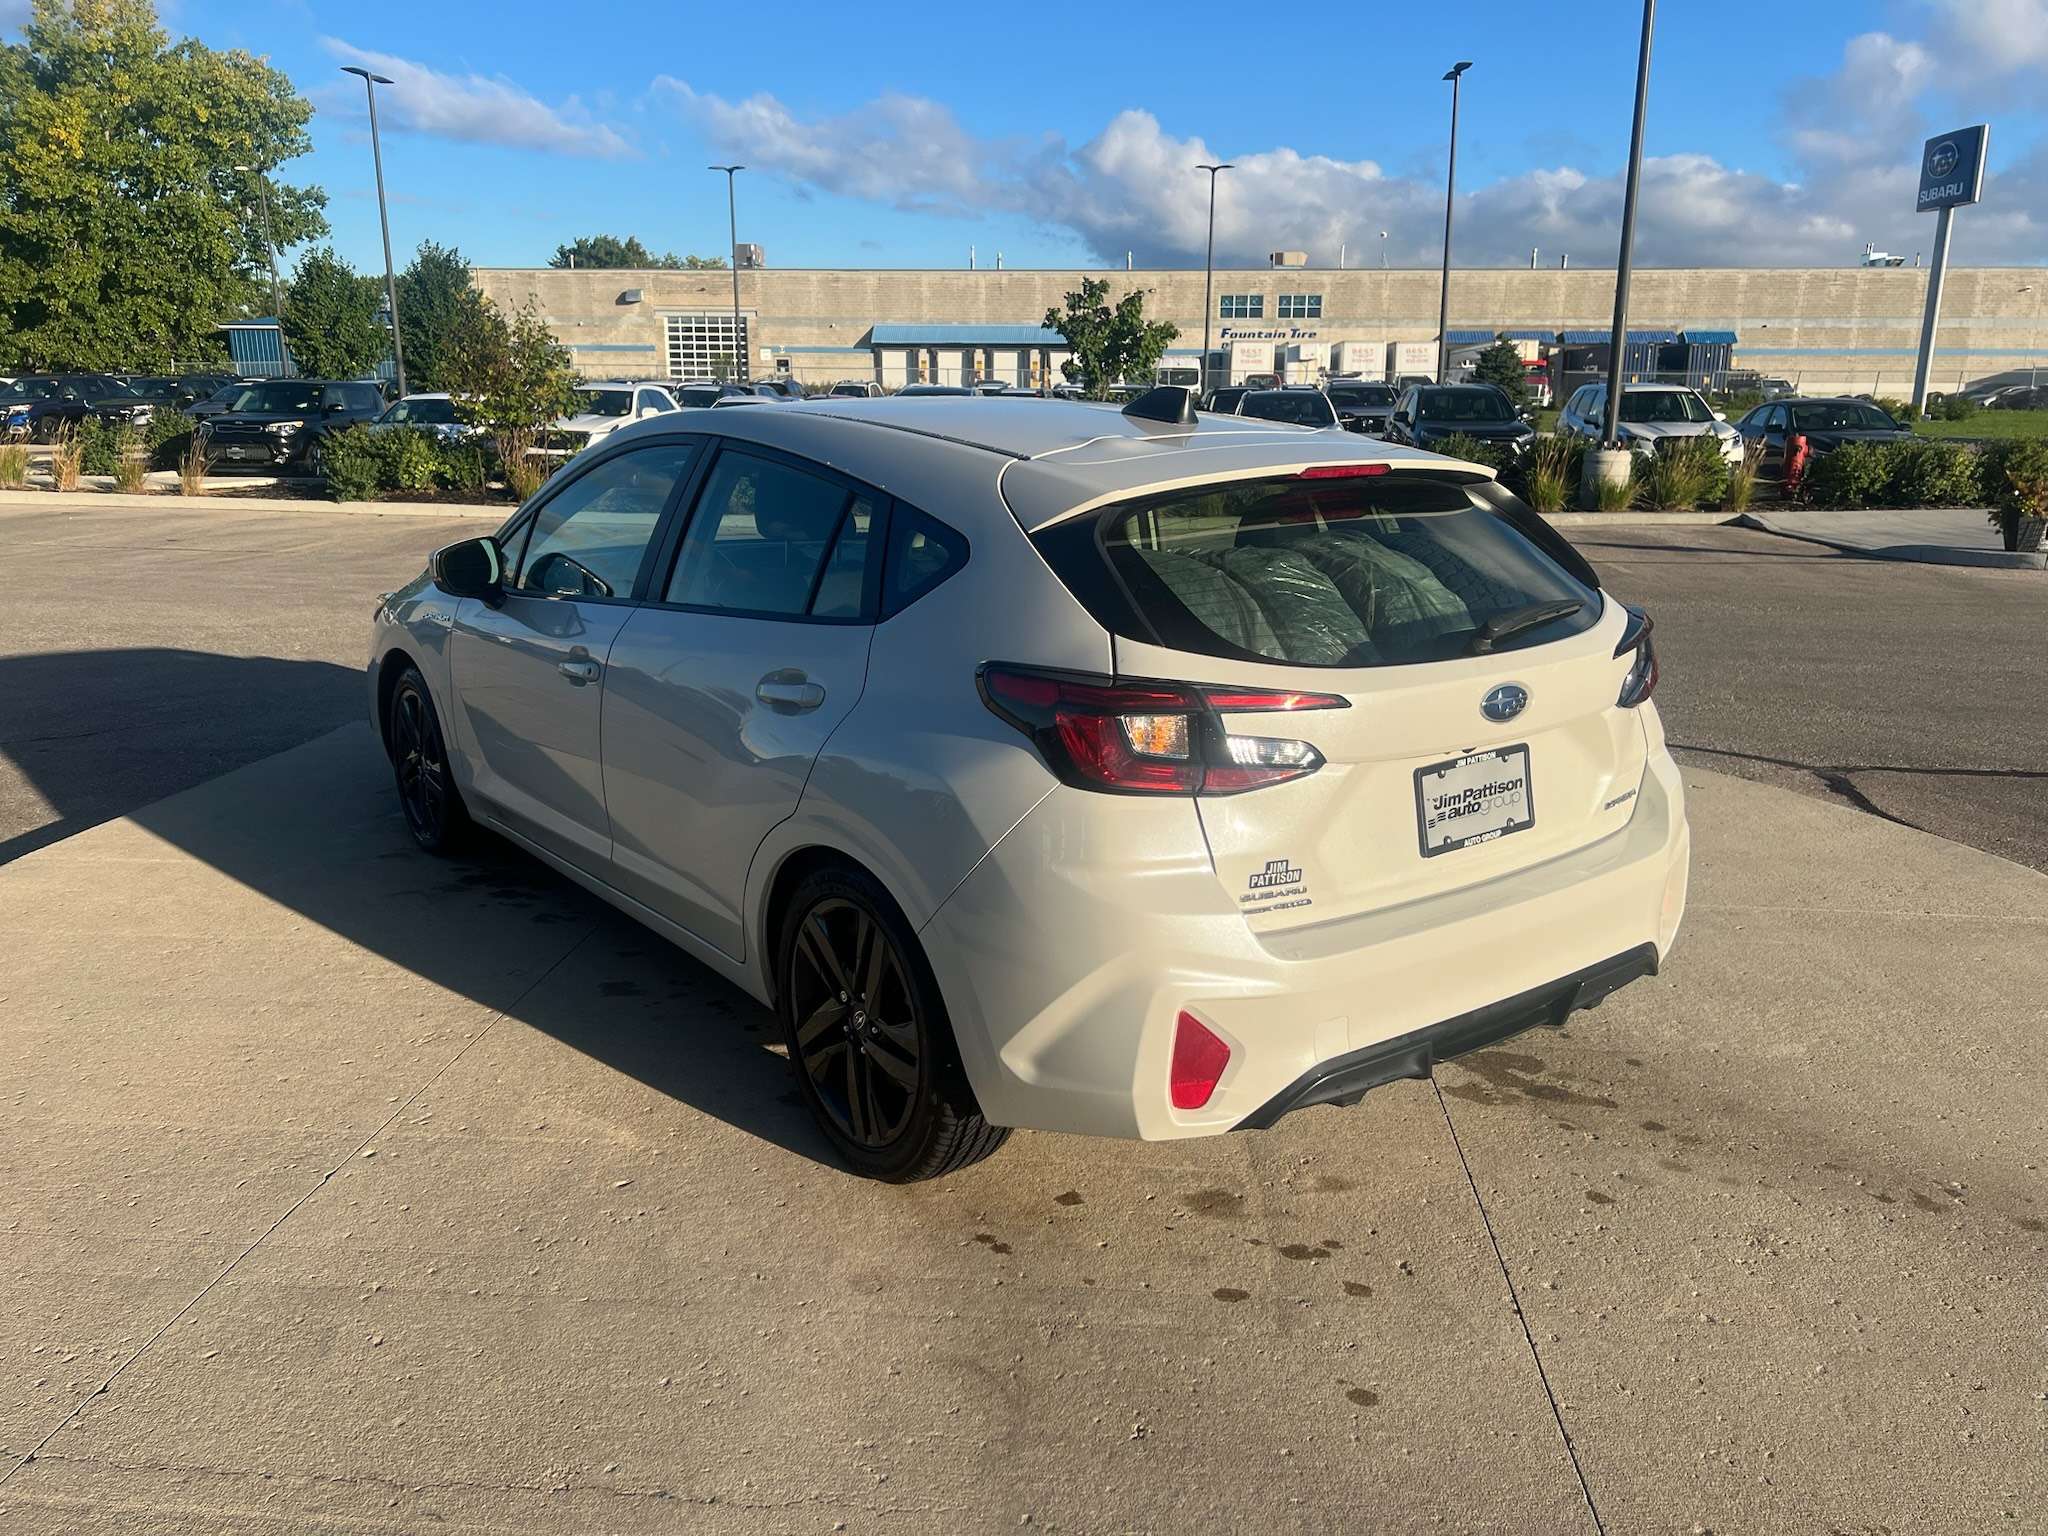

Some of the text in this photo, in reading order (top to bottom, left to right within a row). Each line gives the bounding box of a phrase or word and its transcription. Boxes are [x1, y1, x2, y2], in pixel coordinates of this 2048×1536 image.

[1920, 182, 1964, 203] SUBARU
[1220, 328, 1317, 339] Fountain Tire
[1464, 830, 1502, 848] AUTO GROUP
[1267, 861, 1288, 874] JIM
[1250, 869, 1301, 887] PATTISON
